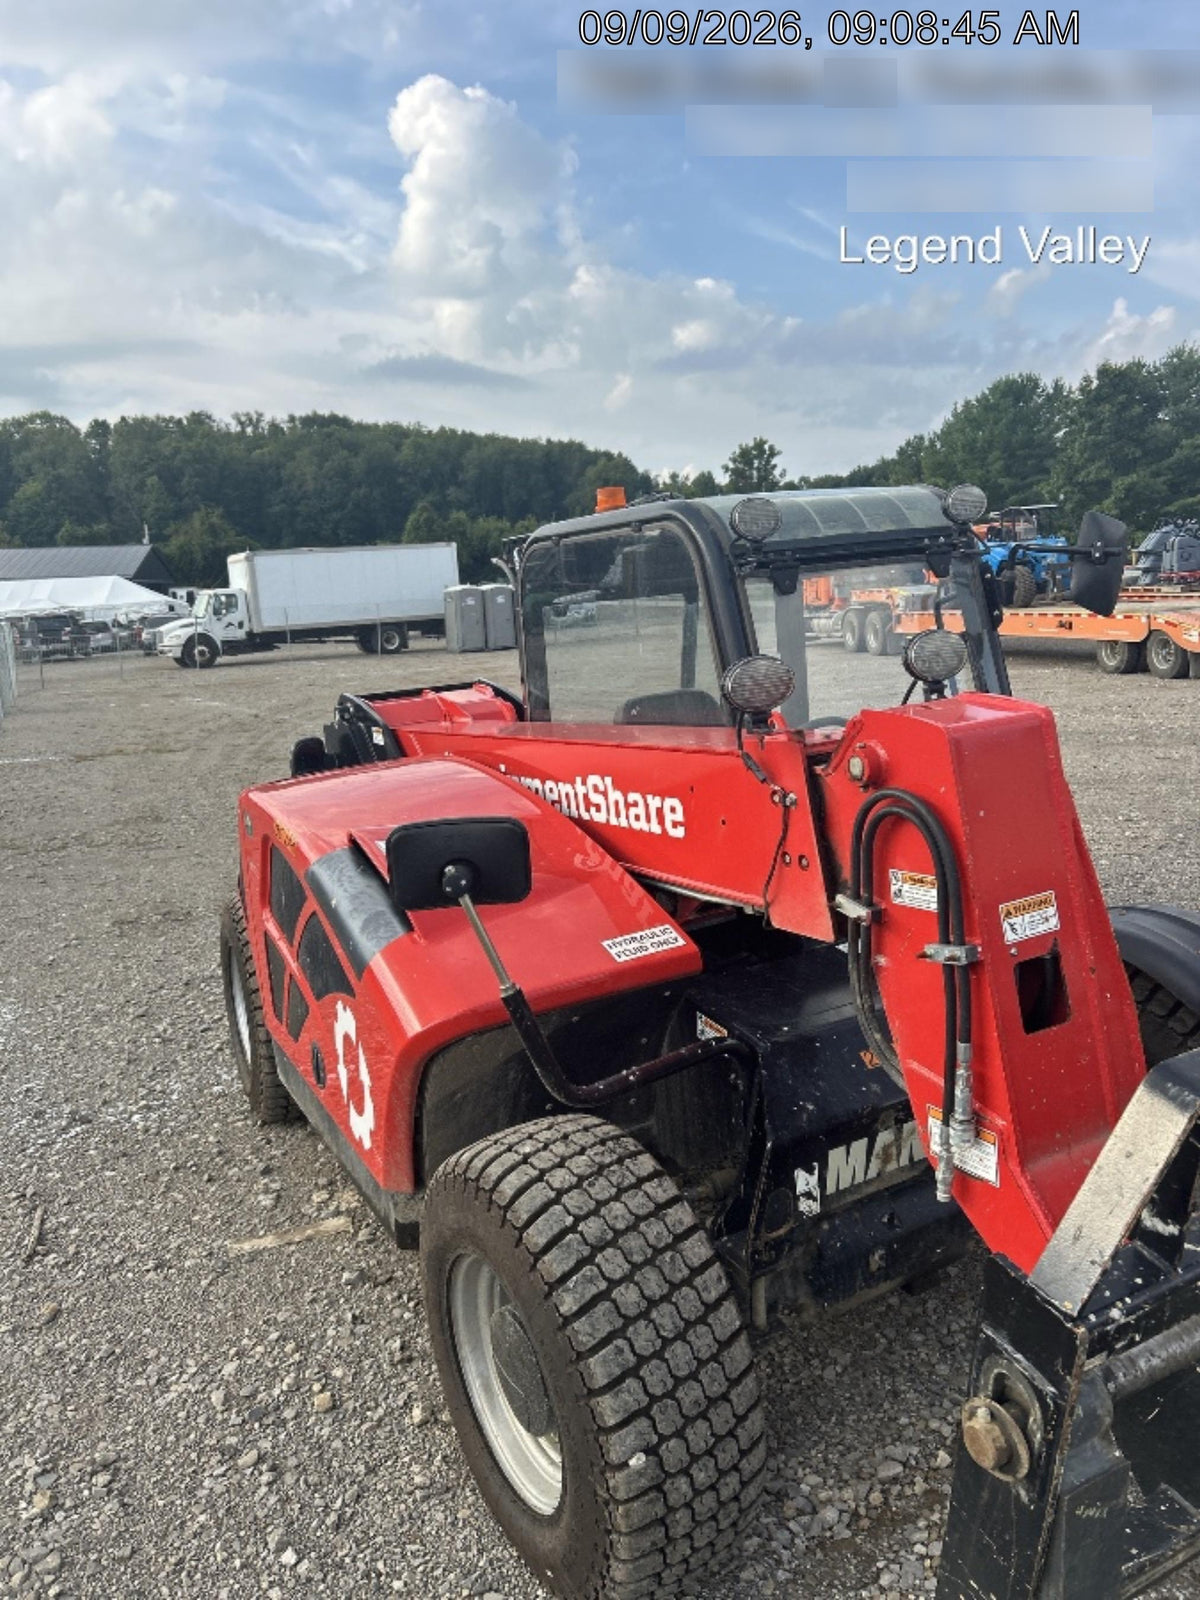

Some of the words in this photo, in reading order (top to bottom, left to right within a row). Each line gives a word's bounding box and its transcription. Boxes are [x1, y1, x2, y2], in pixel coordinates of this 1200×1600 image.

[606, 927, 673, 950] HYDRAULIC
[615, 944, 650, 959] FLUID
[650, 936, 679, 950] ONLY
